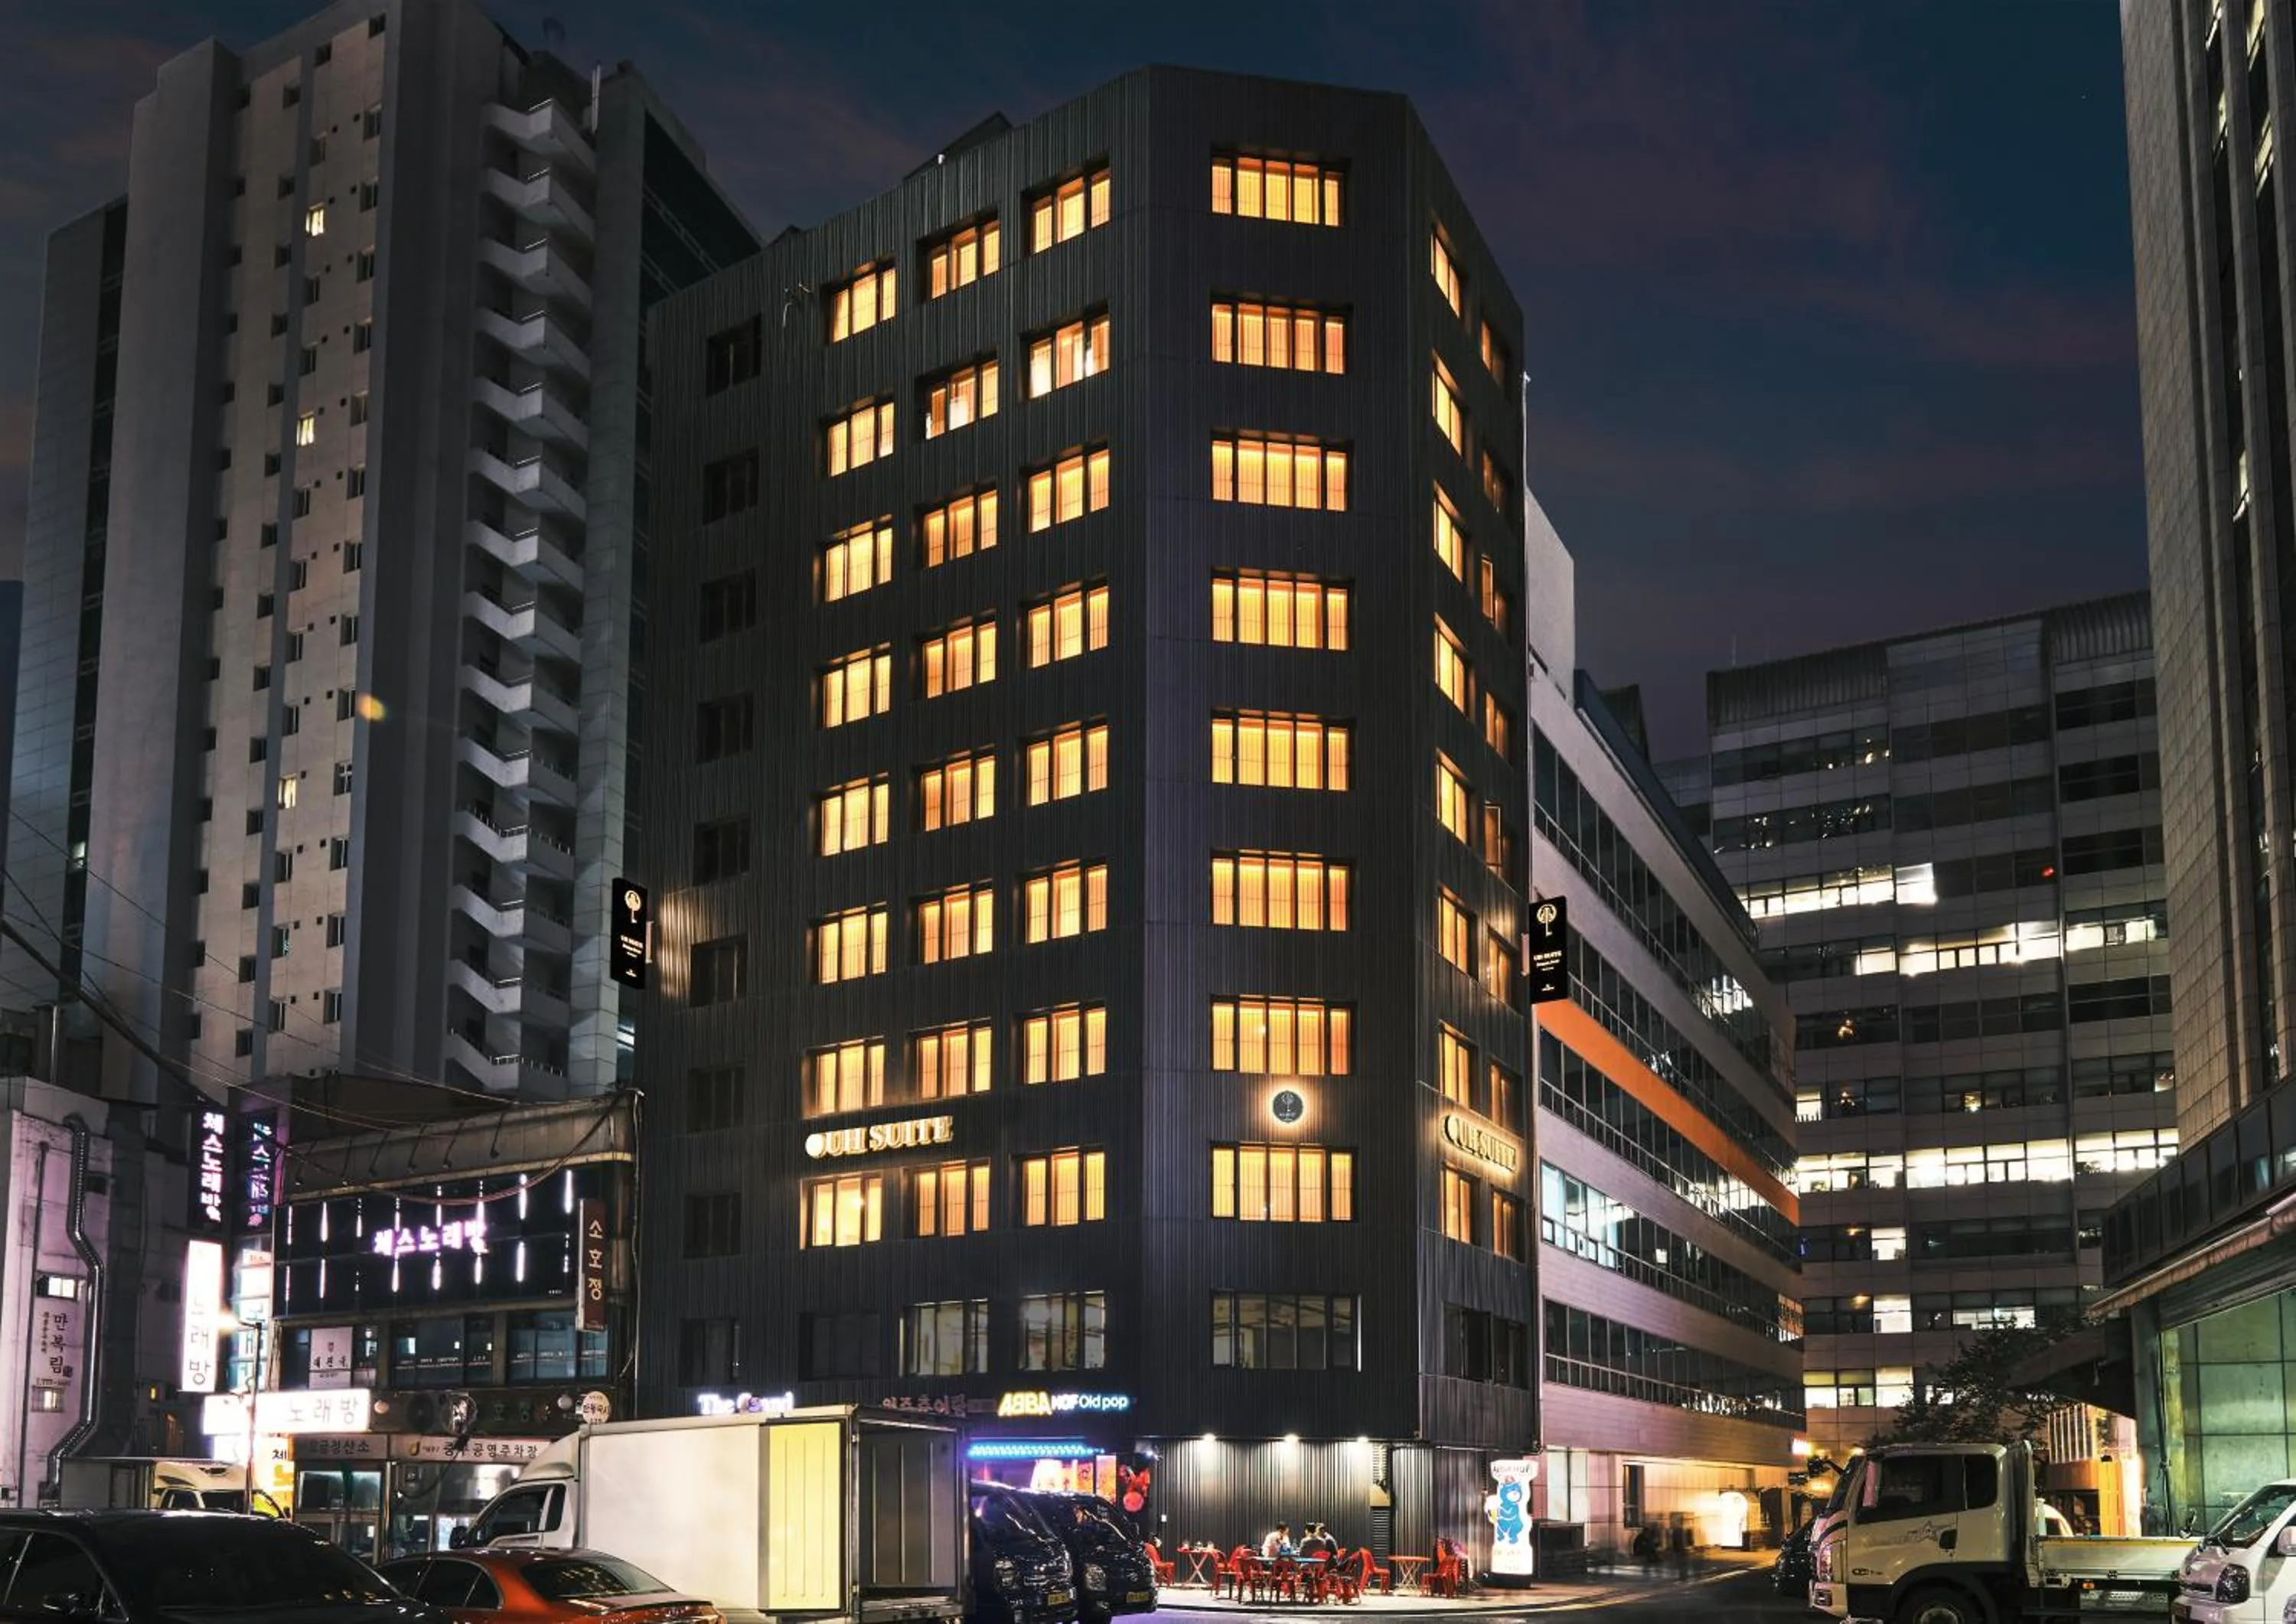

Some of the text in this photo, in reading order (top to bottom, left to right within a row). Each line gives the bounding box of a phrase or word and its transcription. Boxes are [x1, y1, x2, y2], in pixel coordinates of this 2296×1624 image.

[869, 1115, 954, 1152] SUITE
[373, 1221, 490, 1256] 체스노래방
[588, 1219, 603, 1300] 소호정
[50, 1313, 69, 1374] 만복림
[287, 1396, 359, 1425] 노래방
[698, 1393, 735, 1416] The
[998, 1391, 1053, 1416] ABBA
[1079, 1394, 1101, 1409] Old
[1101, 1395, 1129, 1411] pop
[443, 1442, 538, 1458] 중공영주차장
